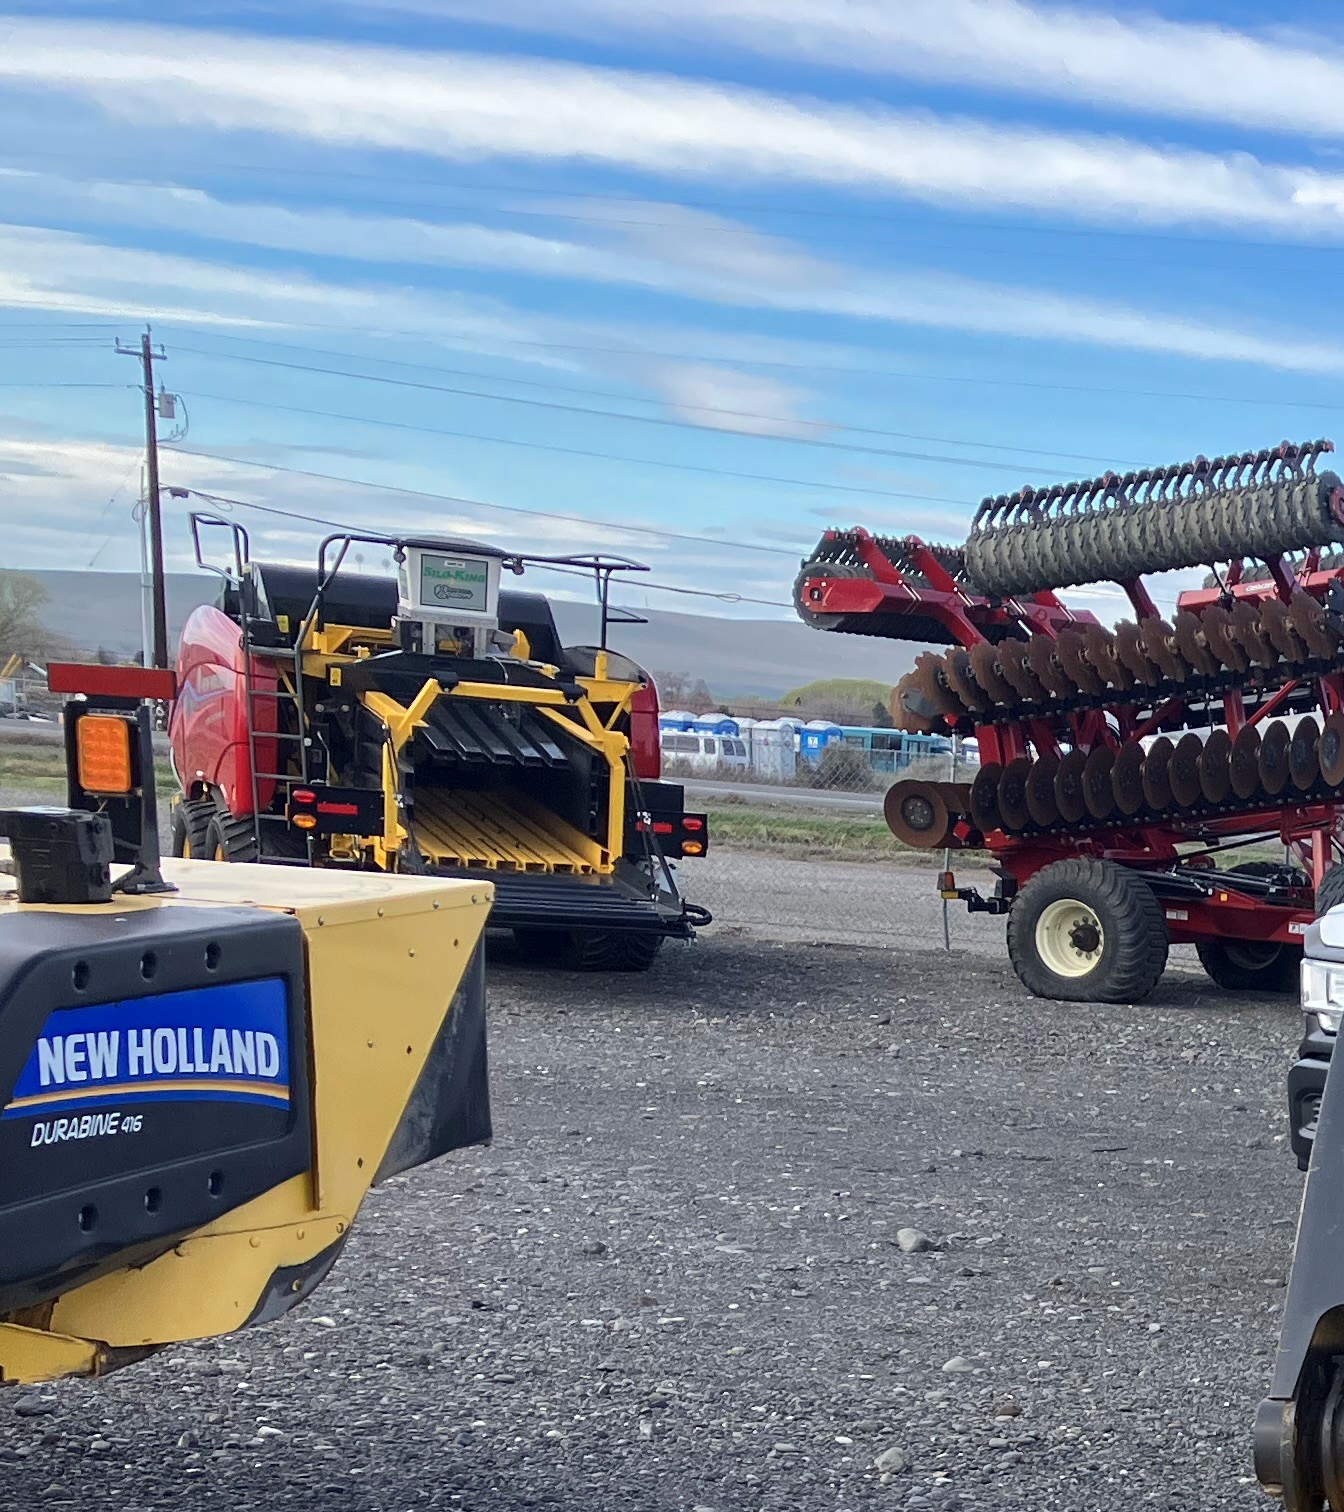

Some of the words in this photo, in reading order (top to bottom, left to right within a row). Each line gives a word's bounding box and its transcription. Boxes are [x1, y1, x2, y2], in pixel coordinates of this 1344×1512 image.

[37, 1030, 120, 1087] NEW
[128, 1027, 280, 1078] HOLLAND
[30, 1112, 121, 1147] DURABINE
[121, 1114, 144, 1133] 416
